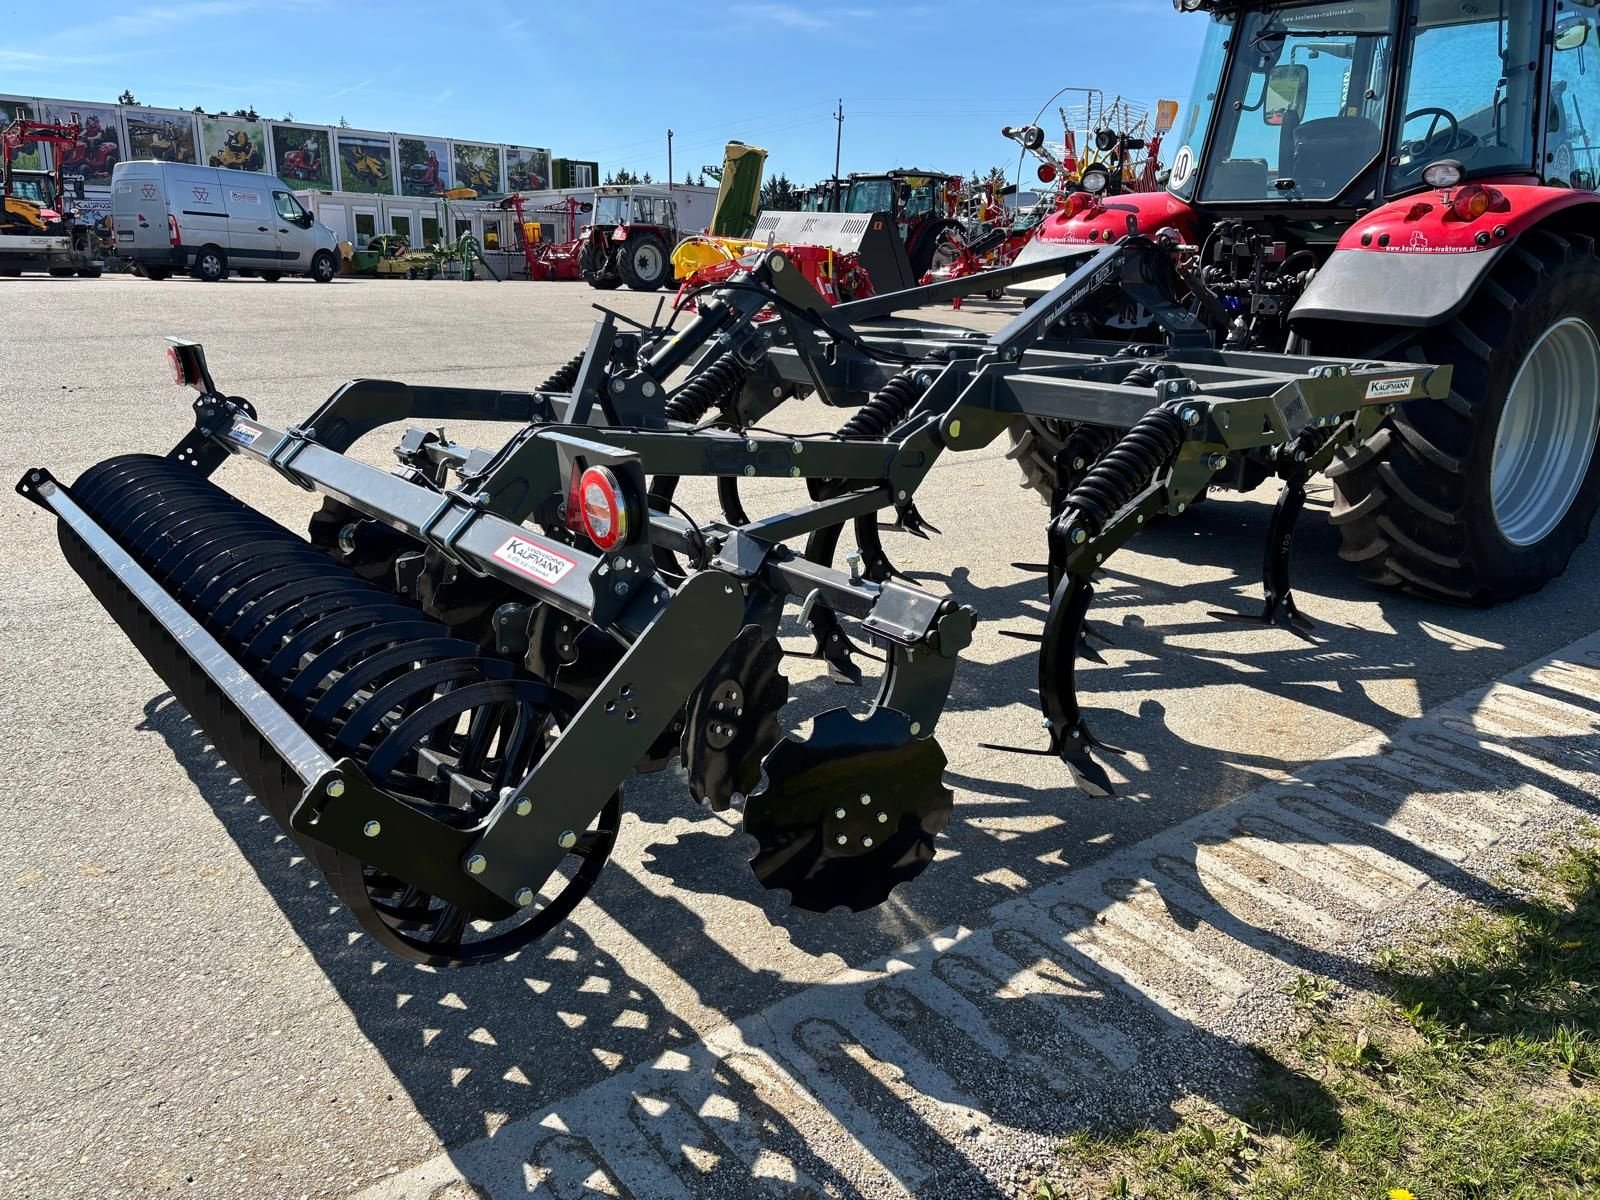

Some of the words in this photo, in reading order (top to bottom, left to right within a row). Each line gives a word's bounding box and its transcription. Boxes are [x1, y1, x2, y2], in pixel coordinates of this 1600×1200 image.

[1173, 153, 1189, 181] 40
[1385, 244, 1478, 253] www.kaufmann-traktoren.at
[1370, 381, 1410, 392] KAUFMANN
[506, 539, 563, 575] KAUFMANN
